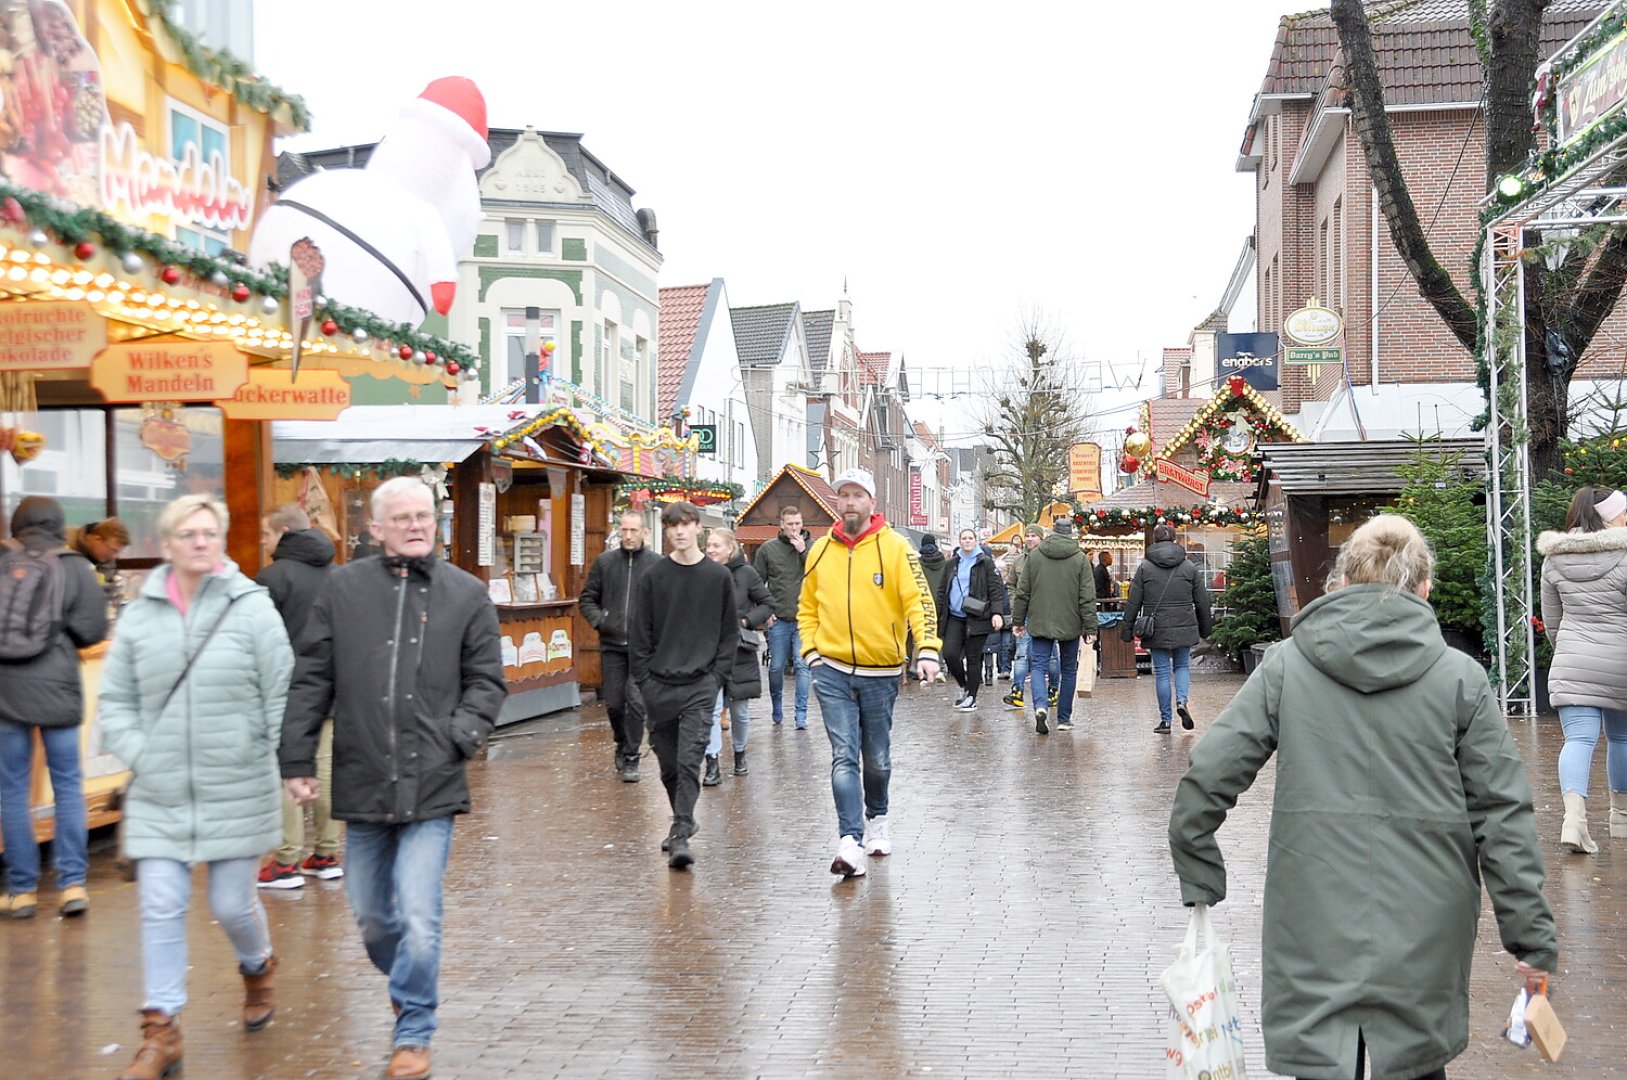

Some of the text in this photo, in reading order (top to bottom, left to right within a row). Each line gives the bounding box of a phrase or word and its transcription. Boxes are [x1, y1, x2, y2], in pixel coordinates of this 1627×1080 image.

[1289, 351, 1339, 361] Darcy's Pub
[127, 374, 214, 394] Mandeln
[235, 385, 347, 405] uckerwatte
[1158, 462, 1205, 492] BRATWURST
[910, 475, 921, 515] schulte
